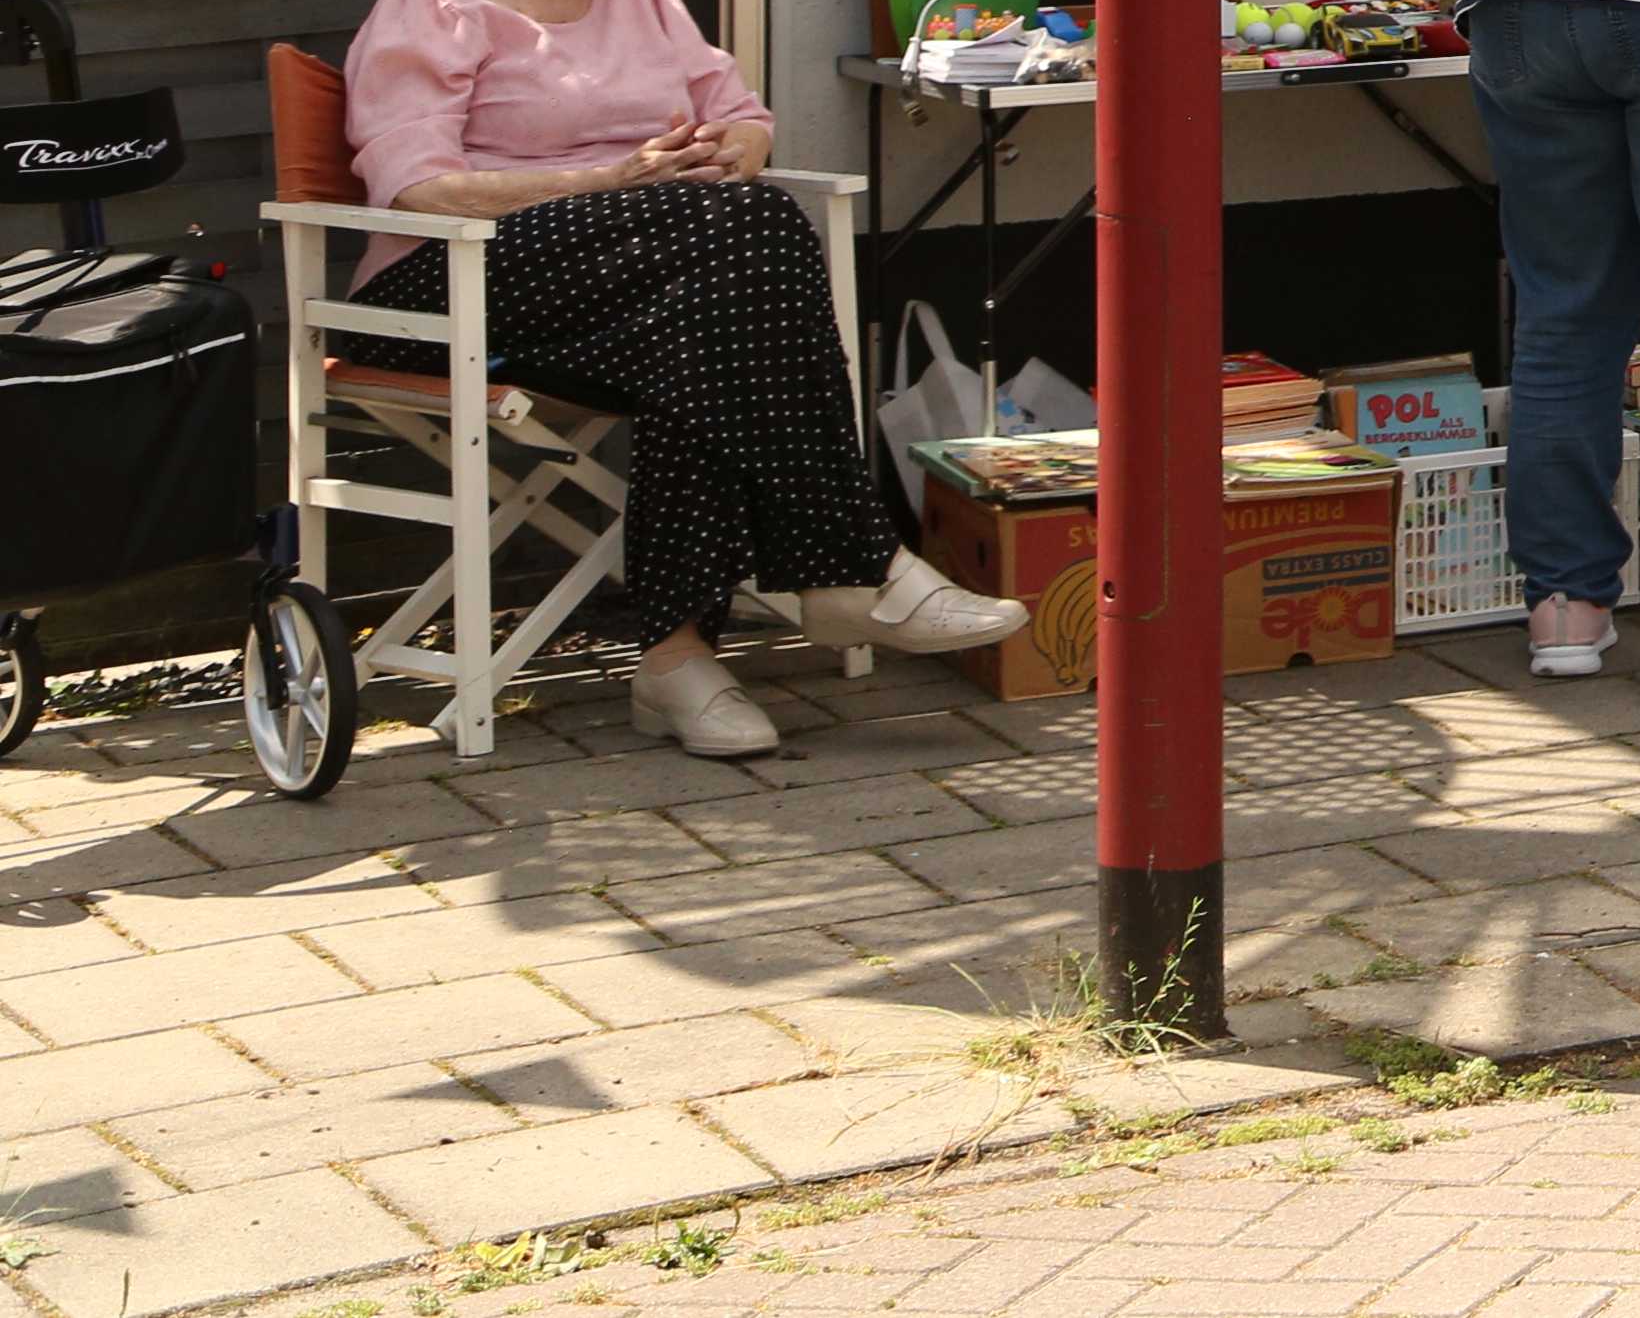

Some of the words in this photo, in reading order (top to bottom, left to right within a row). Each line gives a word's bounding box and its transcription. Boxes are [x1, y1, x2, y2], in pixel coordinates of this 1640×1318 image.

[3, 139, 141, 168] Travixx
[1367, 391, 1440, 429] POL
[1440, 417, 1464, 429] ALS
[1365, 428, 1478, 444] BERGBEKLIMMER
[1266, 558, 1325, 576] EXTRA
[1332, 550, 1385, 571] CLASS
[1261, 584, 1391, 649] Dole
